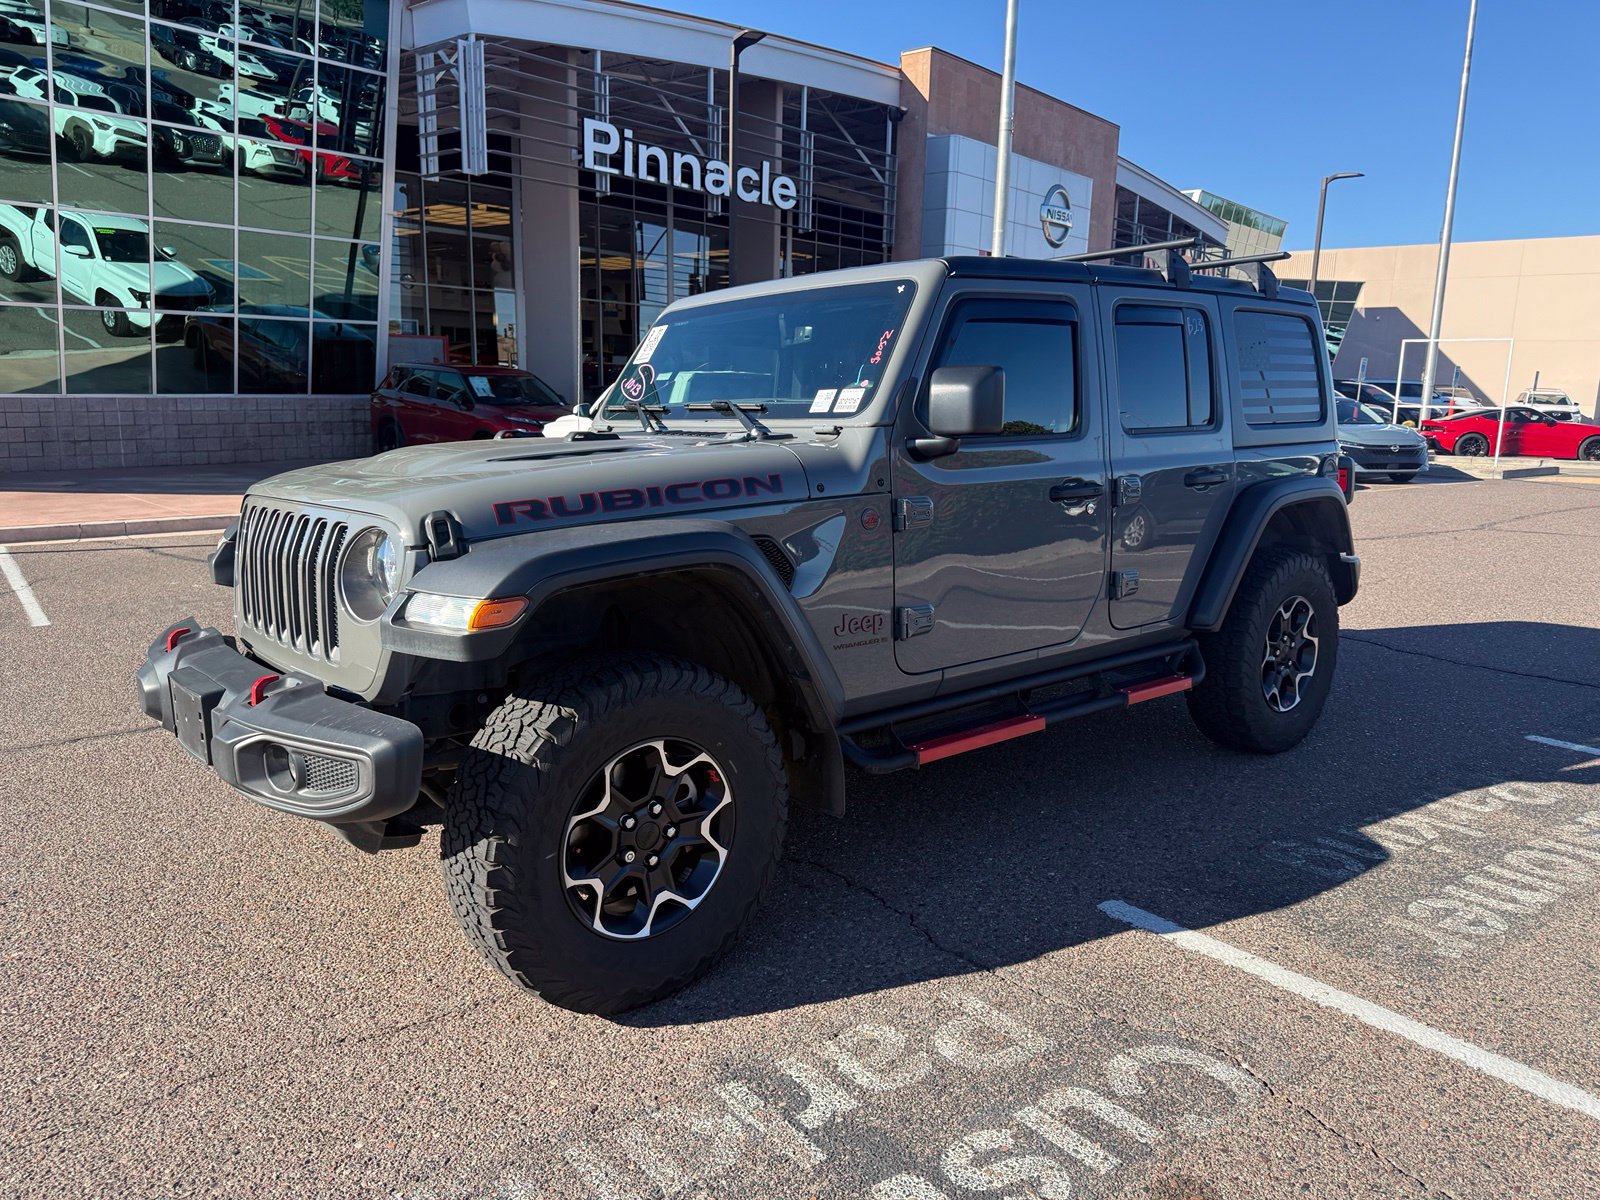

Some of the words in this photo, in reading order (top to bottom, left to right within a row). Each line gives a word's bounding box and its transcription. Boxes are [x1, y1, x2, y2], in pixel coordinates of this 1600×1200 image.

[583, 117, 798, 210] Pinnacle
[491, 473, 785, 526] RUBICON
[832, 638, 881, 650] WRANGLER
[833, 612, 884, 637] Jeep
